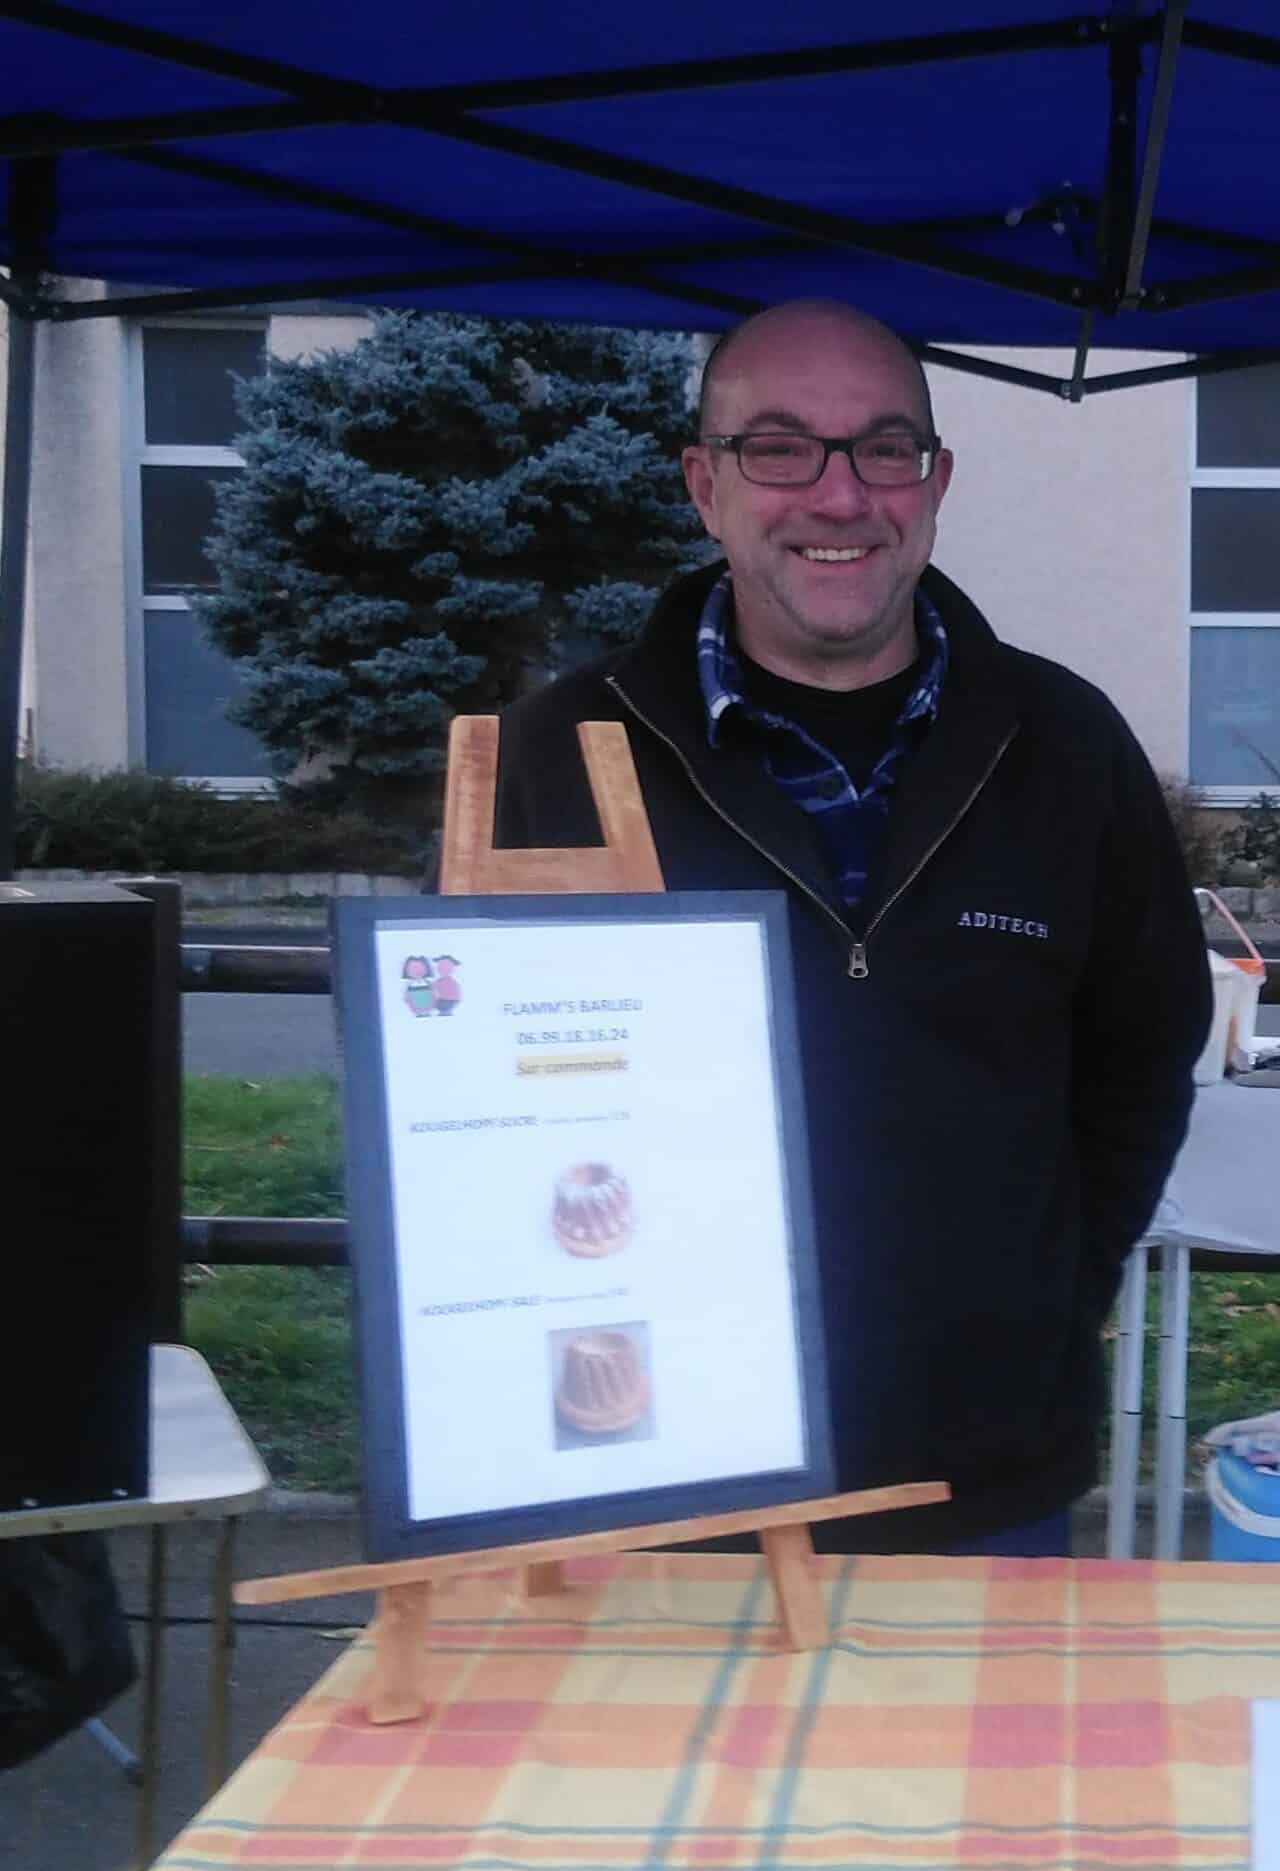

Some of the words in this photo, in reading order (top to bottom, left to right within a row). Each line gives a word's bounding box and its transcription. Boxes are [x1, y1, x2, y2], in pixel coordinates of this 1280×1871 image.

[957, 911, 1048, 938] ADITECH
[502, 1000, 576, 1016] FLAMM'S
[580, 998, 644, 1013] BARLIEU
